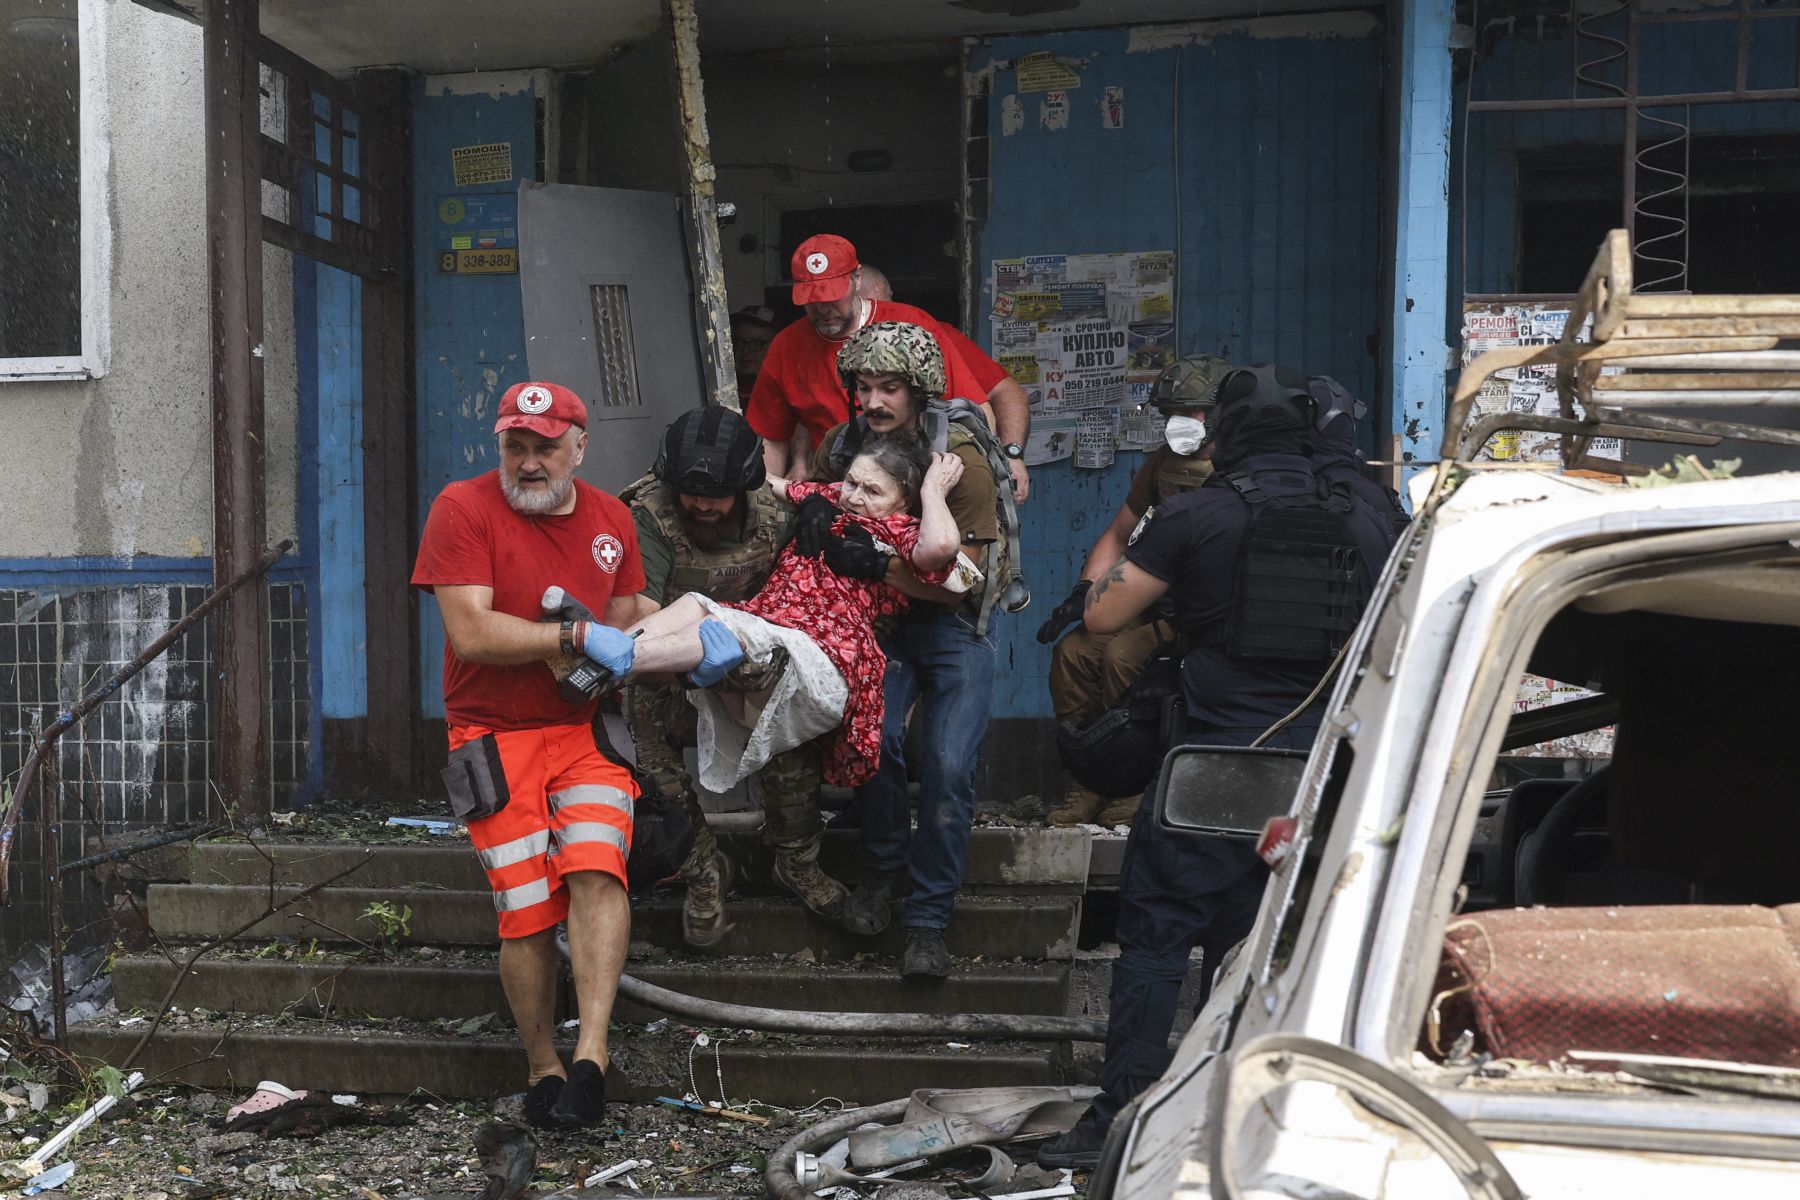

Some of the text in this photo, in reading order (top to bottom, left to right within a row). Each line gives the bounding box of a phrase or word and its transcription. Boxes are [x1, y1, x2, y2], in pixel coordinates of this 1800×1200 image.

[454, 144, 509, 156] ПОМОЩЬ
[442, 253, 456, 271] 8
[463, 254, 512, 268] 338-383
[1075, 322, 1111, 333] СРОЧНО
[1471, 316, 1517, 328] РЕМОНТ
[1063, 331, 1125, 352] КУПЛЮ
[1075, 350, 1115, 368] АВТО
[1064, 375, 1125, 390] 050 219 0444
[1478, 389, 1509, 397] ЕТАЛЛ
